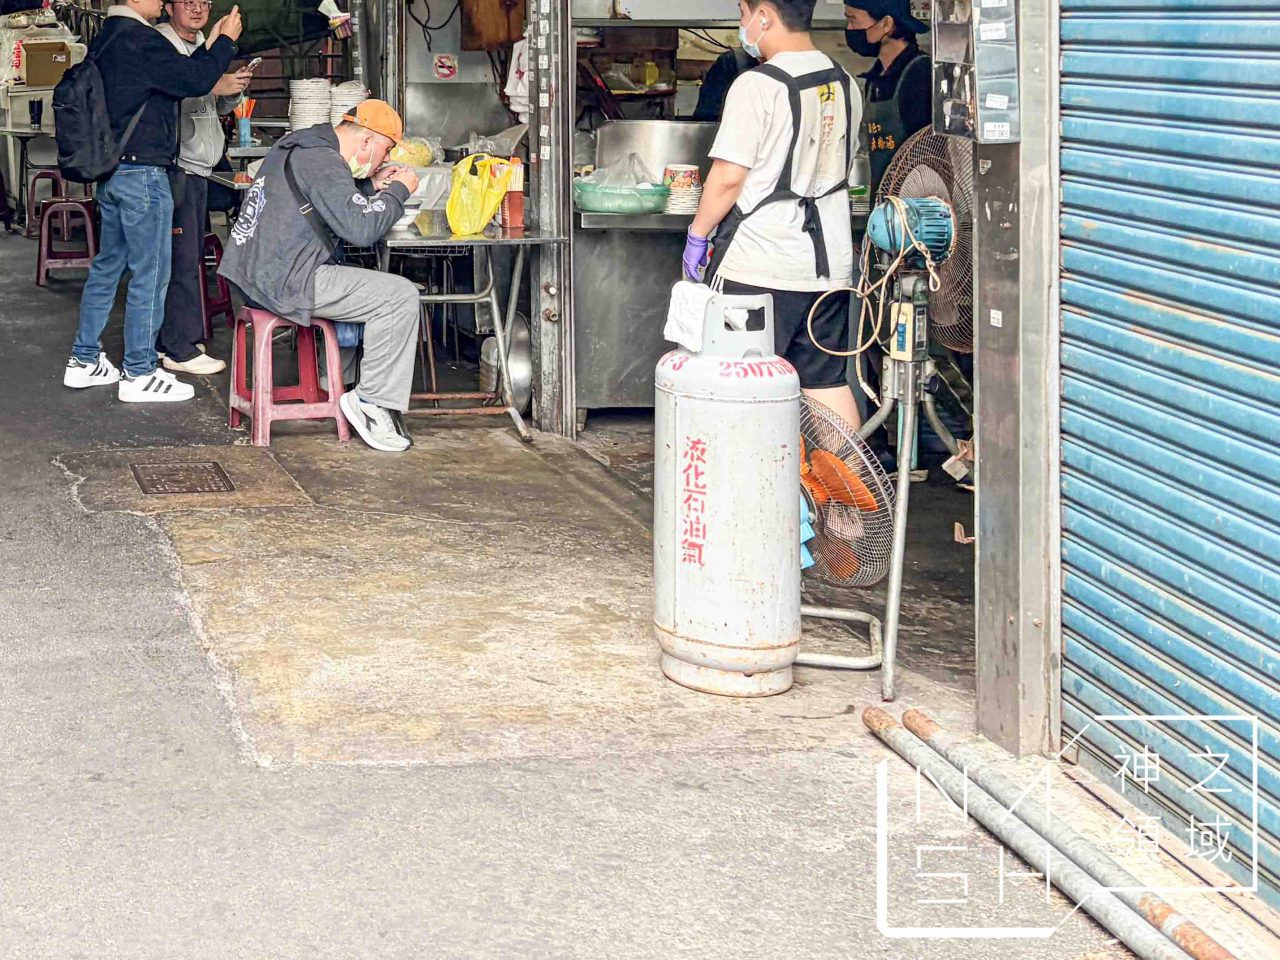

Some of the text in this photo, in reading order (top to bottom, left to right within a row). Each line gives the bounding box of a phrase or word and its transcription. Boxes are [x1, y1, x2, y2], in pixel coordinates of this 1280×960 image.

[682, 435, 707, 569] 液化石油氣
